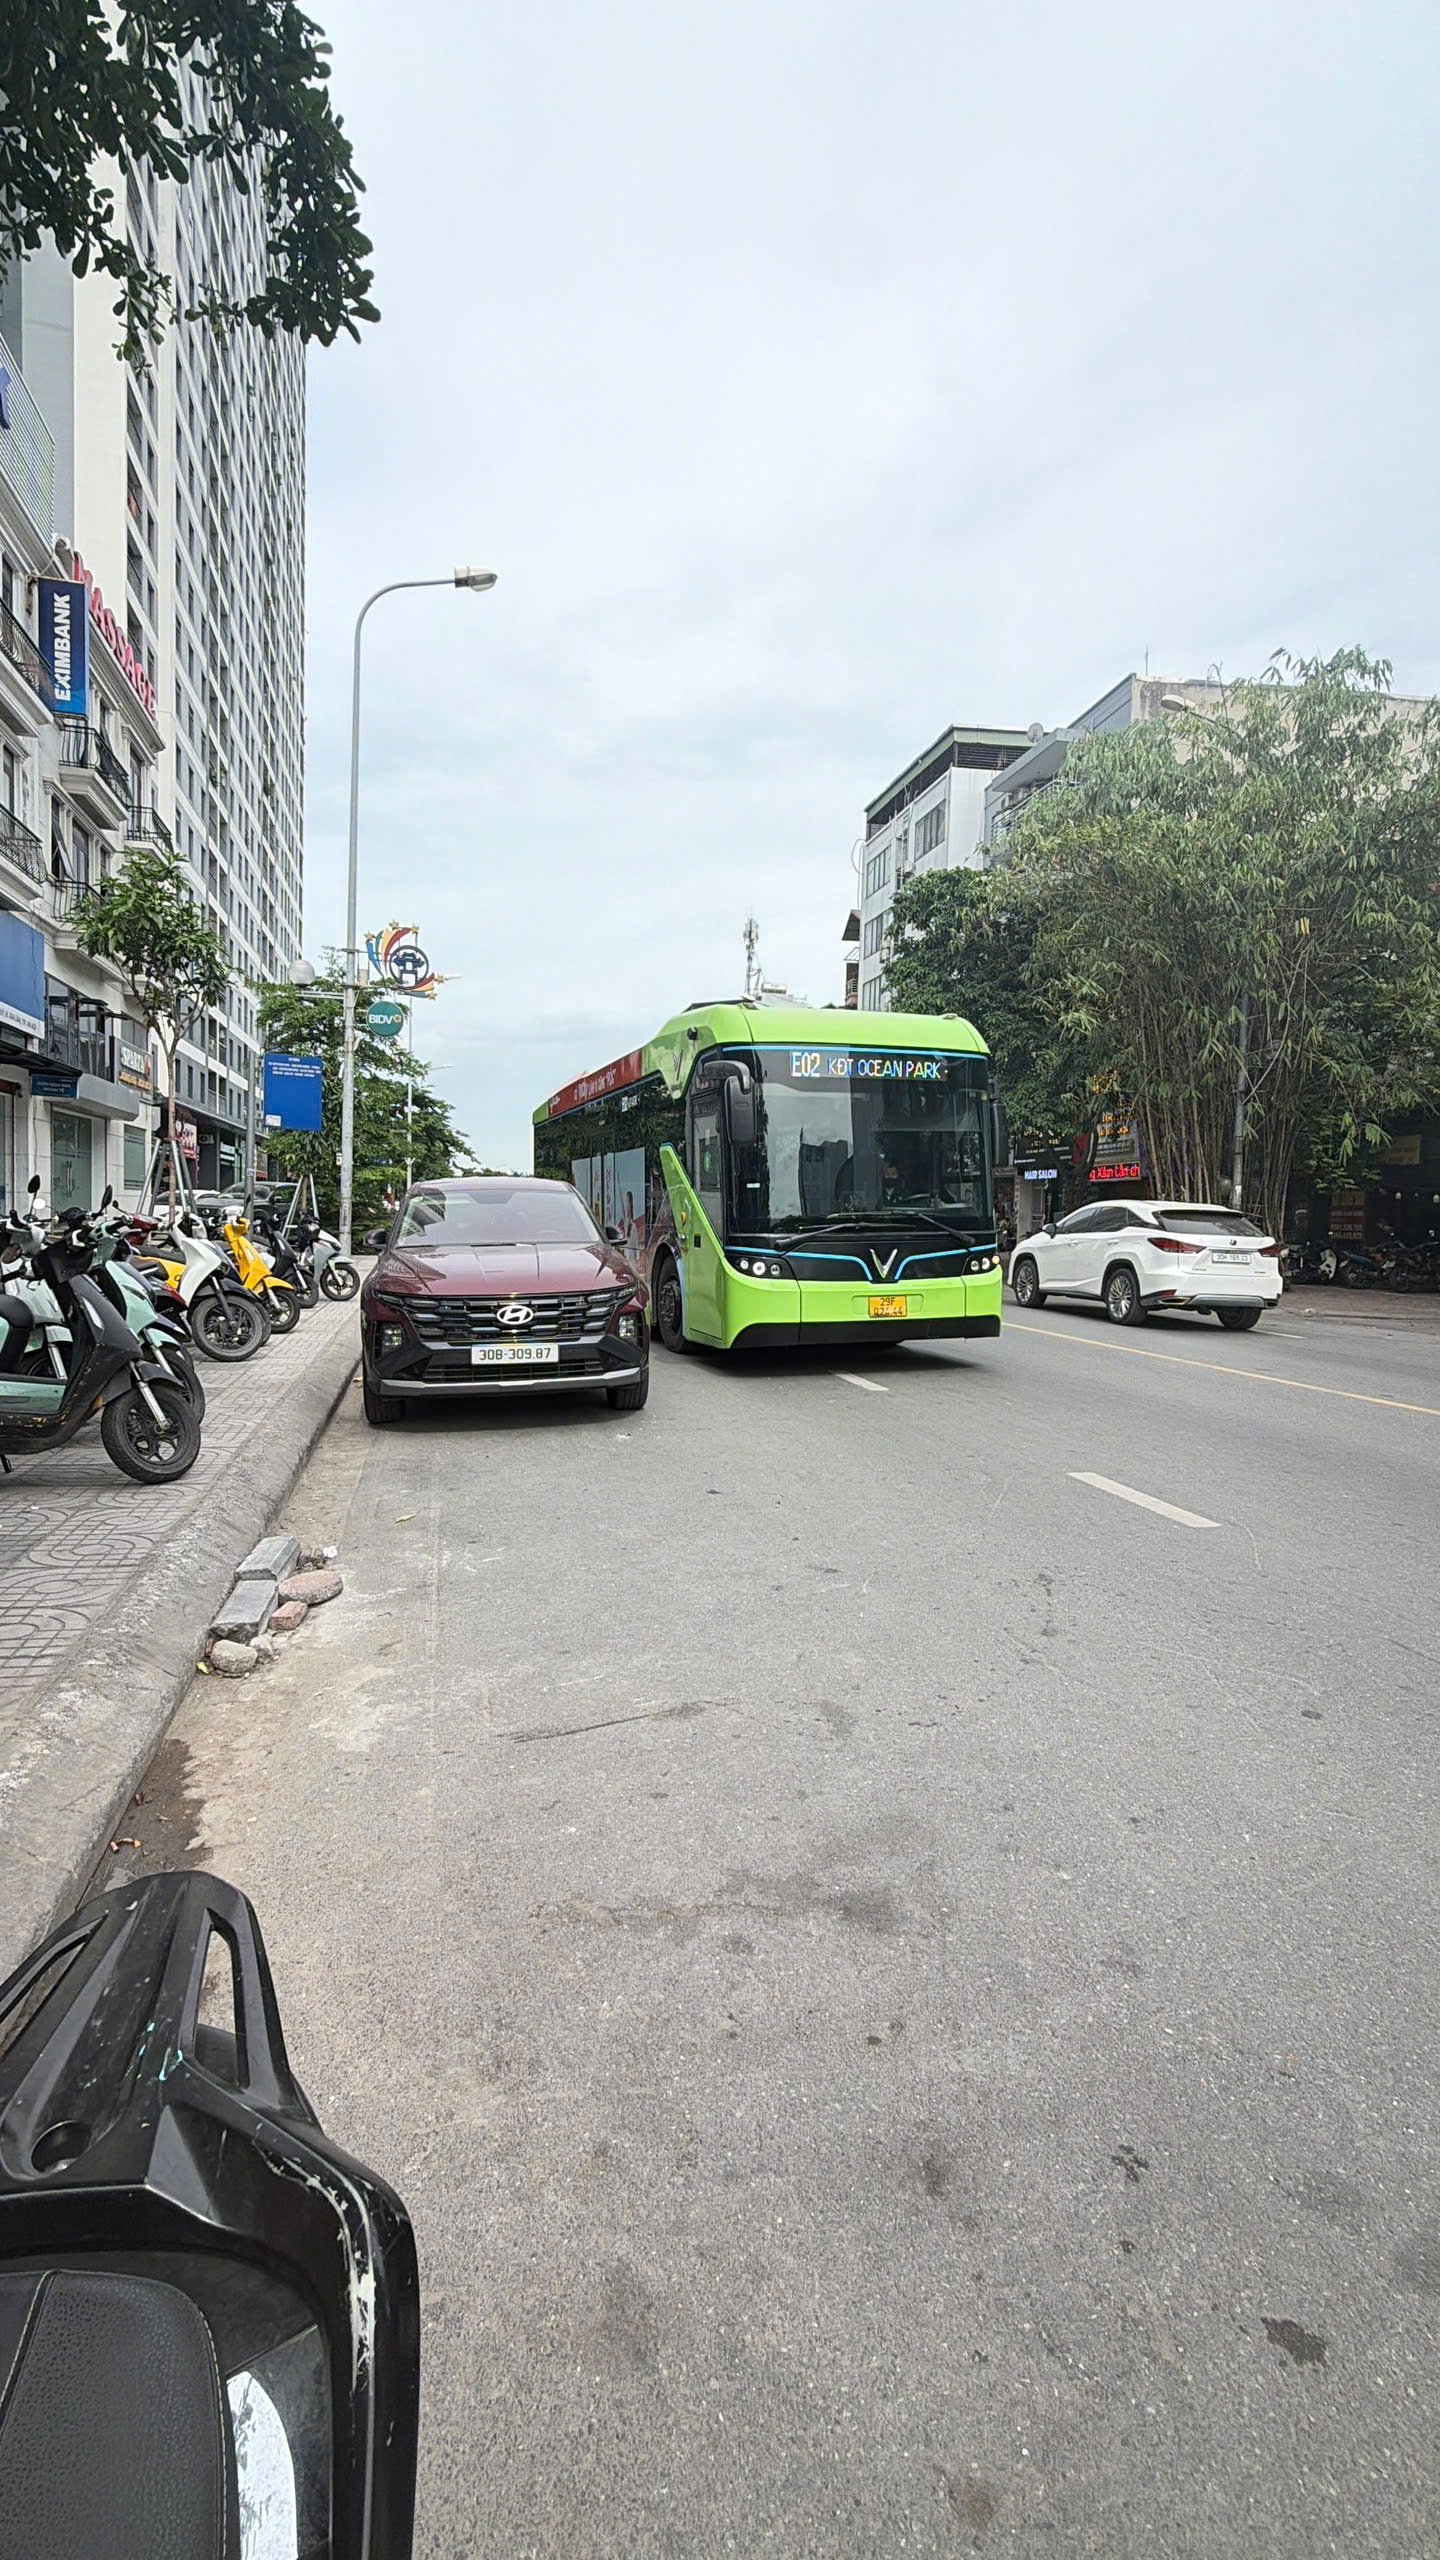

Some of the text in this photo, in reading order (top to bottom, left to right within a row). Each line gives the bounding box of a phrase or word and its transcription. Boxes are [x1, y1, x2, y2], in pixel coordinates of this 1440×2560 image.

[53, 592, 71, 702] EXIMBANK
[368, 1014, 393, 1025] BIDV
[791, 1051, 942, 1079] E02 KĐT OCEAN PARK
[1024, 1168, 1058, 1180] HAIR SALON
[879, 1297, 896, 1307] 29F
[479, 1347, 552, 1361] 30B-309.87
